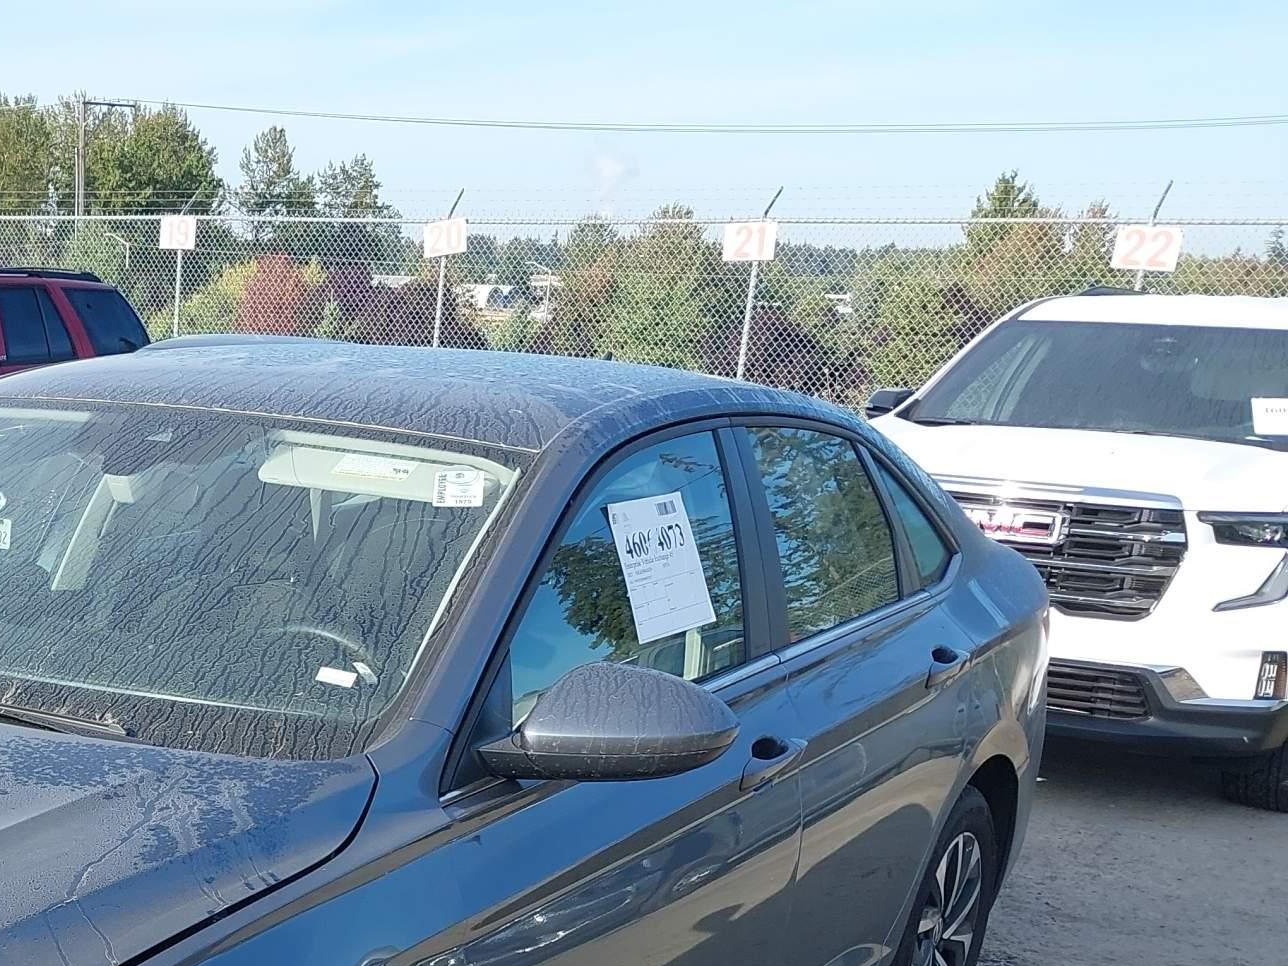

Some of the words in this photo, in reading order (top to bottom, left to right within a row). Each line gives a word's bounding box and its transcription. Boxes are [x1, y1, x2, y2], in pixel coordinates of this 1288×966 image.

[168, 219, 189, 245] 19
[430, 221, 462, 255] 20
[732, 223, 767, 257] 21
[1119, 229, 1174, 267] 22
